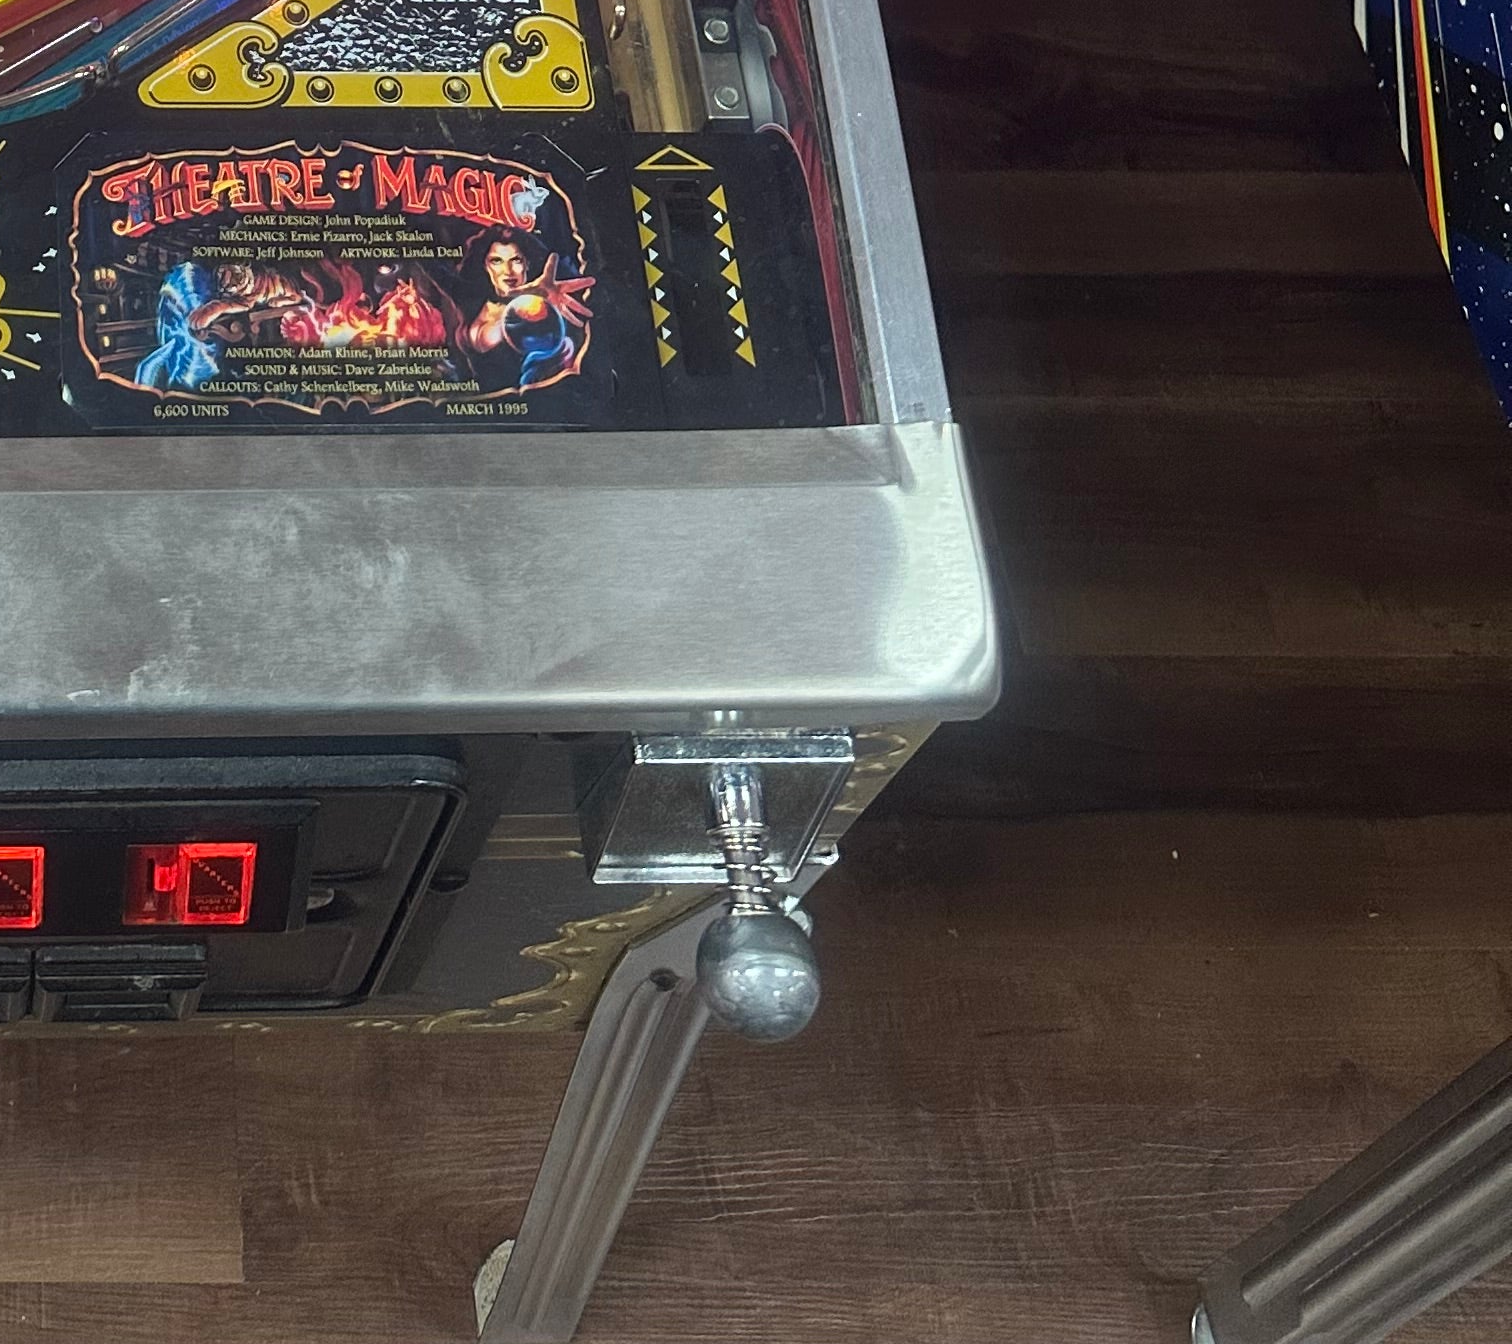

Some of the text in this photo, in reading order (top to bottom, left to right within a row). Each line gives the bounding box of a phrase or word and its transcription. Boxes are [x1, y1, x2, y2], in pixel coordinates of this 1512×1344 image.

[102, 158, 336, 237] THEATRE
[371, 155, 536, 232] MAGIC
[243, 214, 406, 226] GAME DESIGN: John Popadiuk
[220, 231, 433, 242] MECHANICS: Ernie Pizarro, Jack Skalon
[192, 247, 324, 259] SOFTWARE: Jeff Johnson
[340, 246, 463, 258] ARTWORK: Linda Deal
[226, 347, 448, 359] ANIMATION: Adam Rhine, Brian Morris
[245, 364, 431, 376] SOUND & MUSIC: Dave Zabriskie
[200, 381, 261, 394] CALLOUTS:
[264, 381, 298, 394] Cathy
[300, 380, 382, 393] Schenkelberg,
[384, 380, 414, 393] Mike
[154, 404, 228, 416] 6,600 UNITS
[447, 403, 527, 415] MARCH 1995
